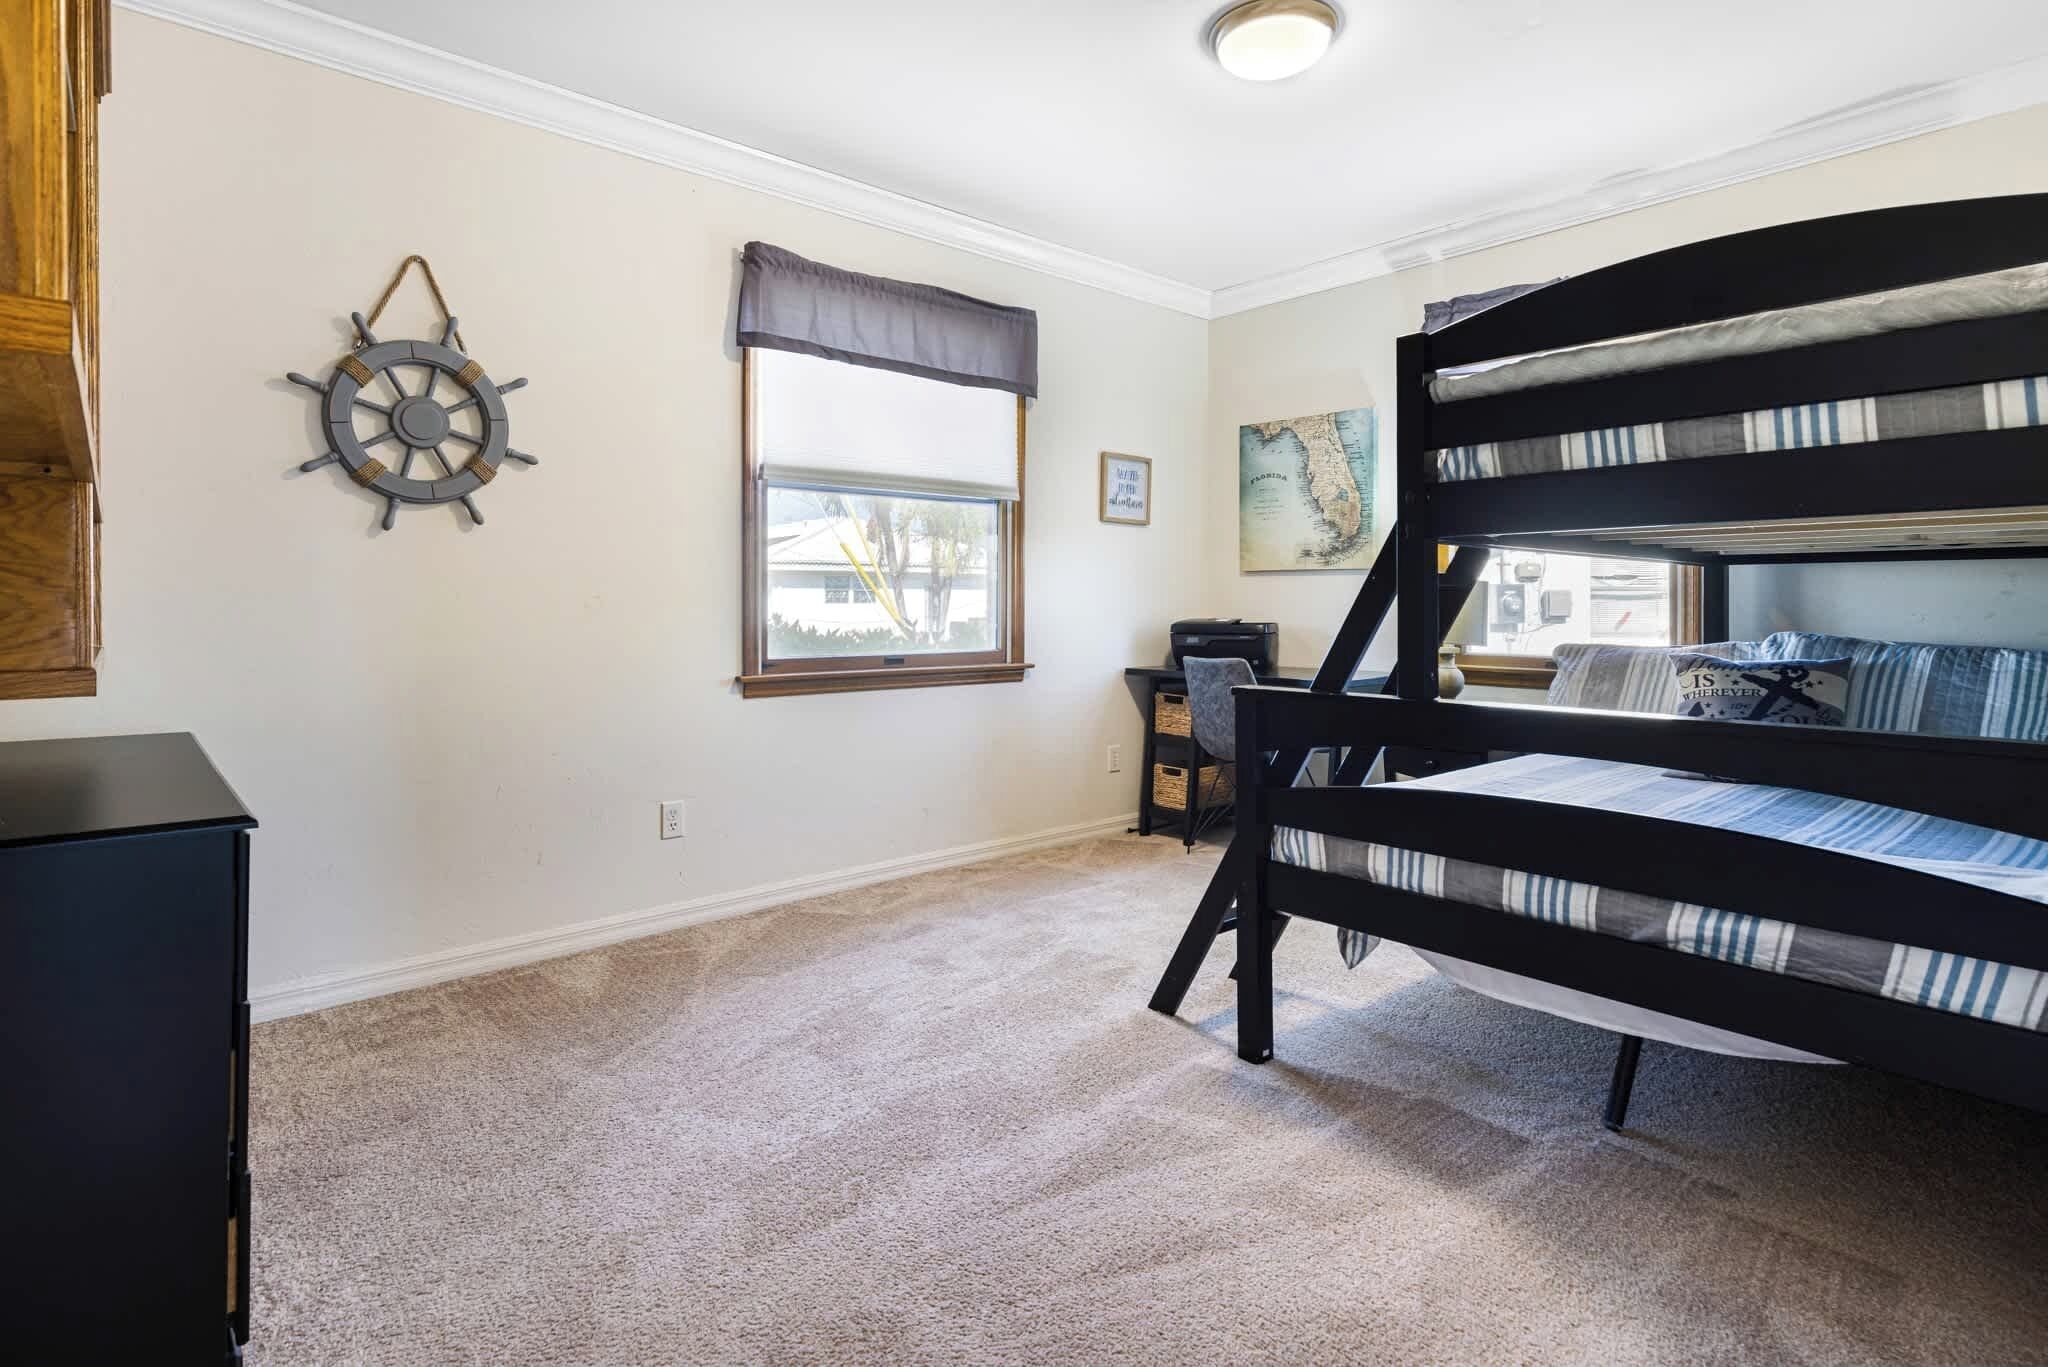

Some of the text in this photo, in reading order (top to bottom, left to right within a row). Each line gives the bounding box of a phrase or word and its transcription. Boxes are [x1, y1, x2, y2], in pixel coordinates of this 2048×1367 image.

[1250, 473, 1288, 485] FLORIDA
[1694, 674, 1715, 688] IS
[1682, 688, 1761, 701] WHEREVER
